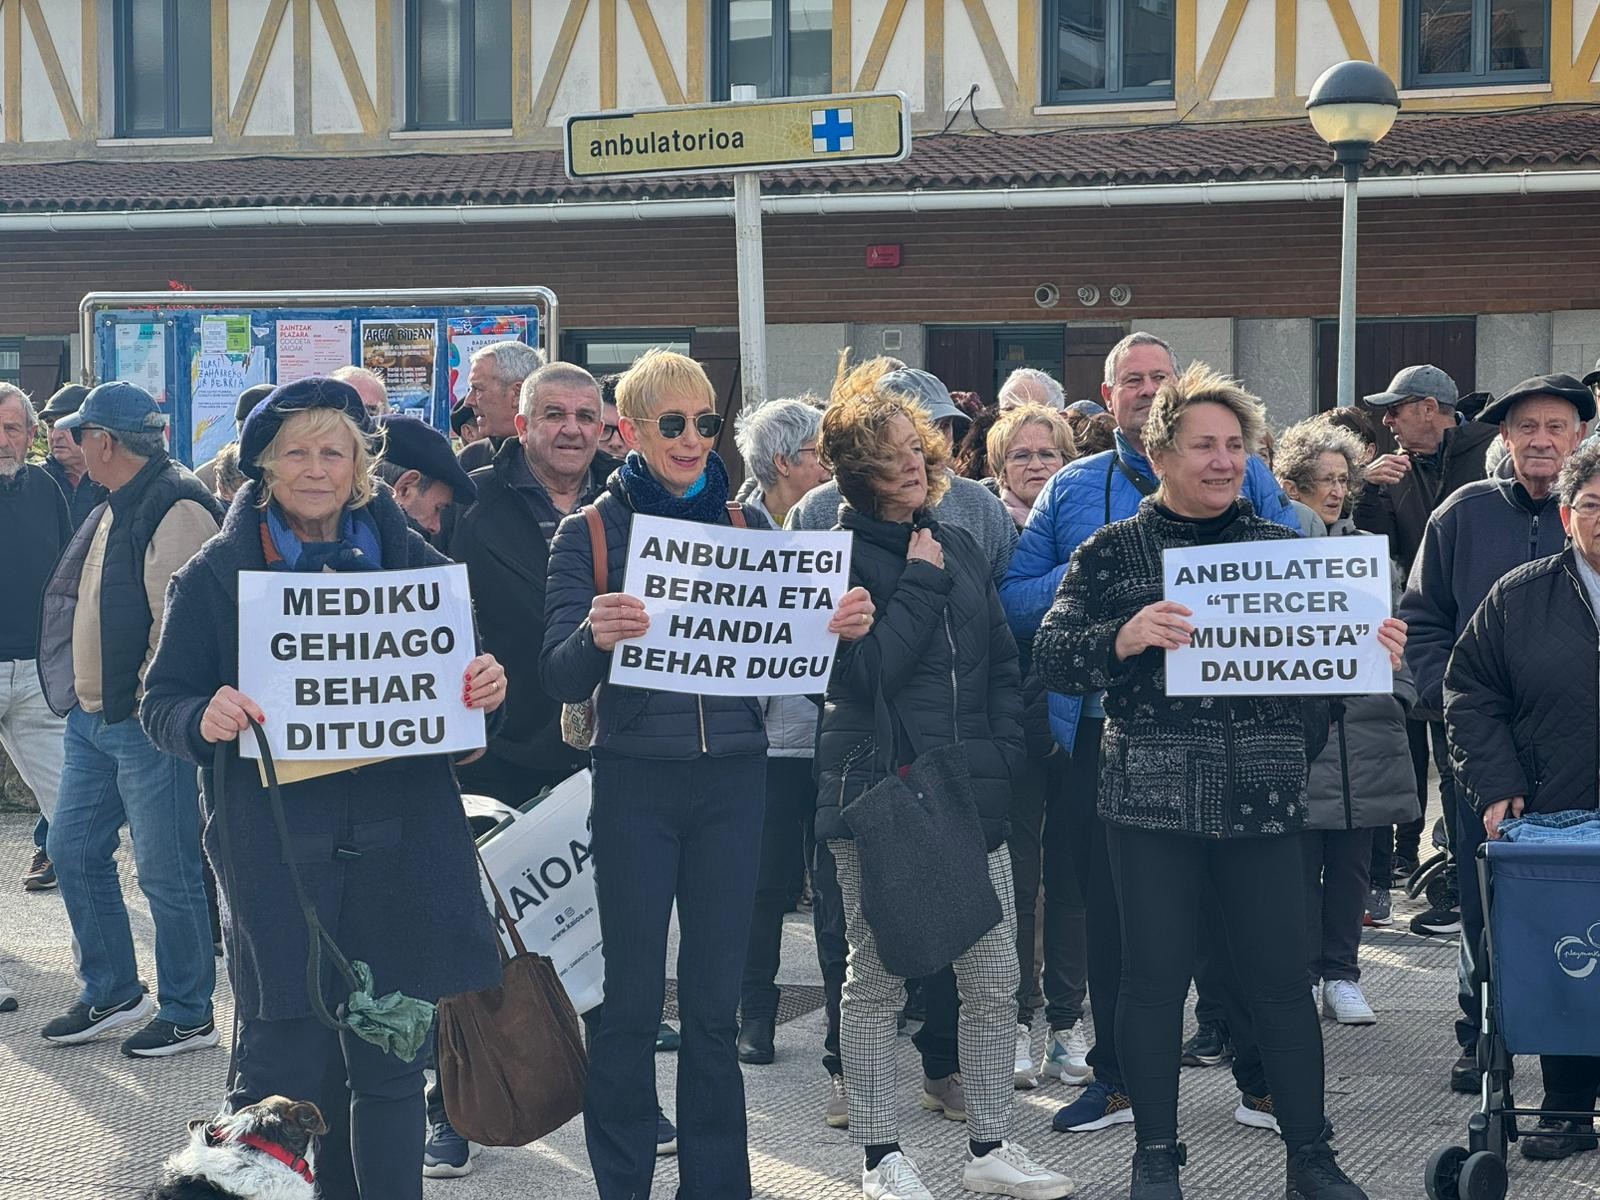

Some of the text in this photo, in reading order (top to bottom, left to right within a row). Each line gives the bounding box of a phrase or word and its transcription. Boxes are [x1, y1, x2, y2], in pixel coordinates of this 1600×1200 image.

[590, 128, 744, 157] anbulatorioa
[397, 327, 434, 340] BIDEAN
[640, 536, 842, 574] ANBULATEGI
[1174, 557, 1378, 585] ANBULATEGI
[283, 582, 440, 616] MEDIKU
[644, 574, 834, 610] BERRIA ETA
[1207, 591, 1349, 614] “TERCER
[270, 626, 455, 661] GEHIAGO
[669, 614, 792, 644] HANDIA
[1190, 624, 1370, 649] MUNDISTA”
[620, 644, 829, 679] BEHAR DUGU
[1201, 658, 1357, 682] DAUKAGU
[295, 673, 437, 706] BEHAR
[287, 716, 445, 750] DITUGU
